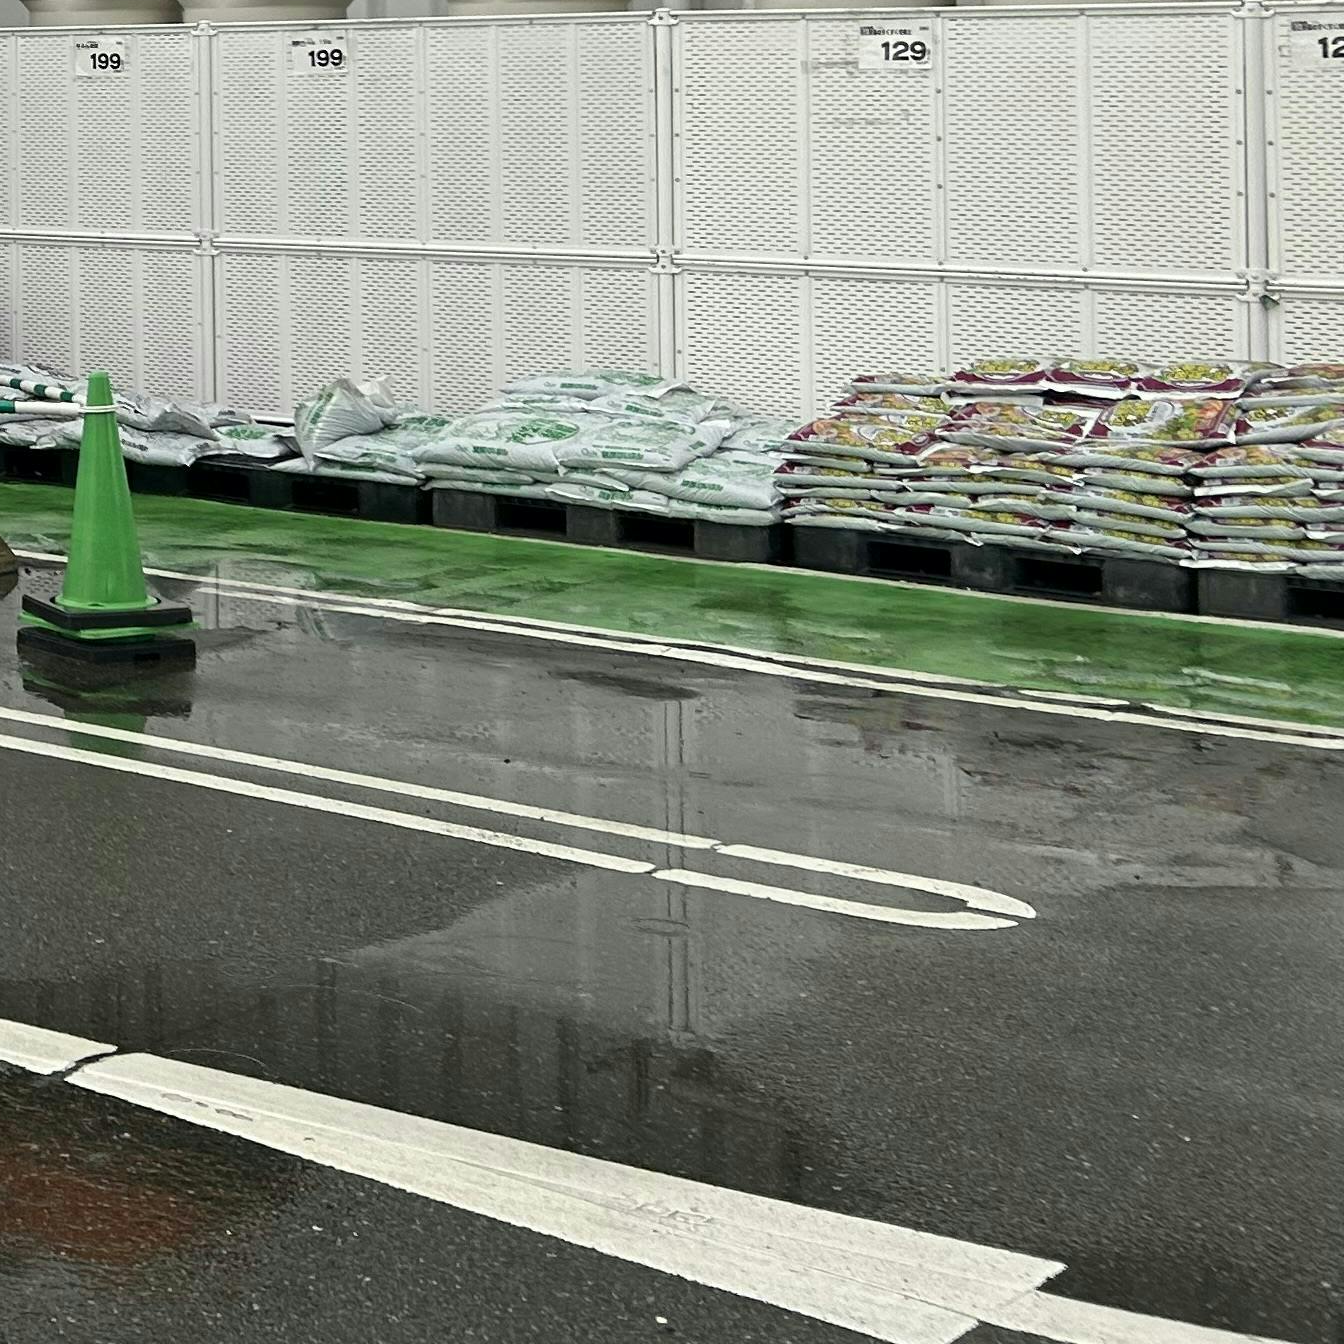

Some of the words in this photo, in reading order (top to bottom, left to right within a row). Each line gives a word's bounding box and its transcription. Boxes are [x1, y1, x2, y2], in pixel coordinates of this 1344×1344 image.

[308, 48, 343, 67] 199
[881, 40, 927, 61] 129
[90, 53, 121, 69] 199
